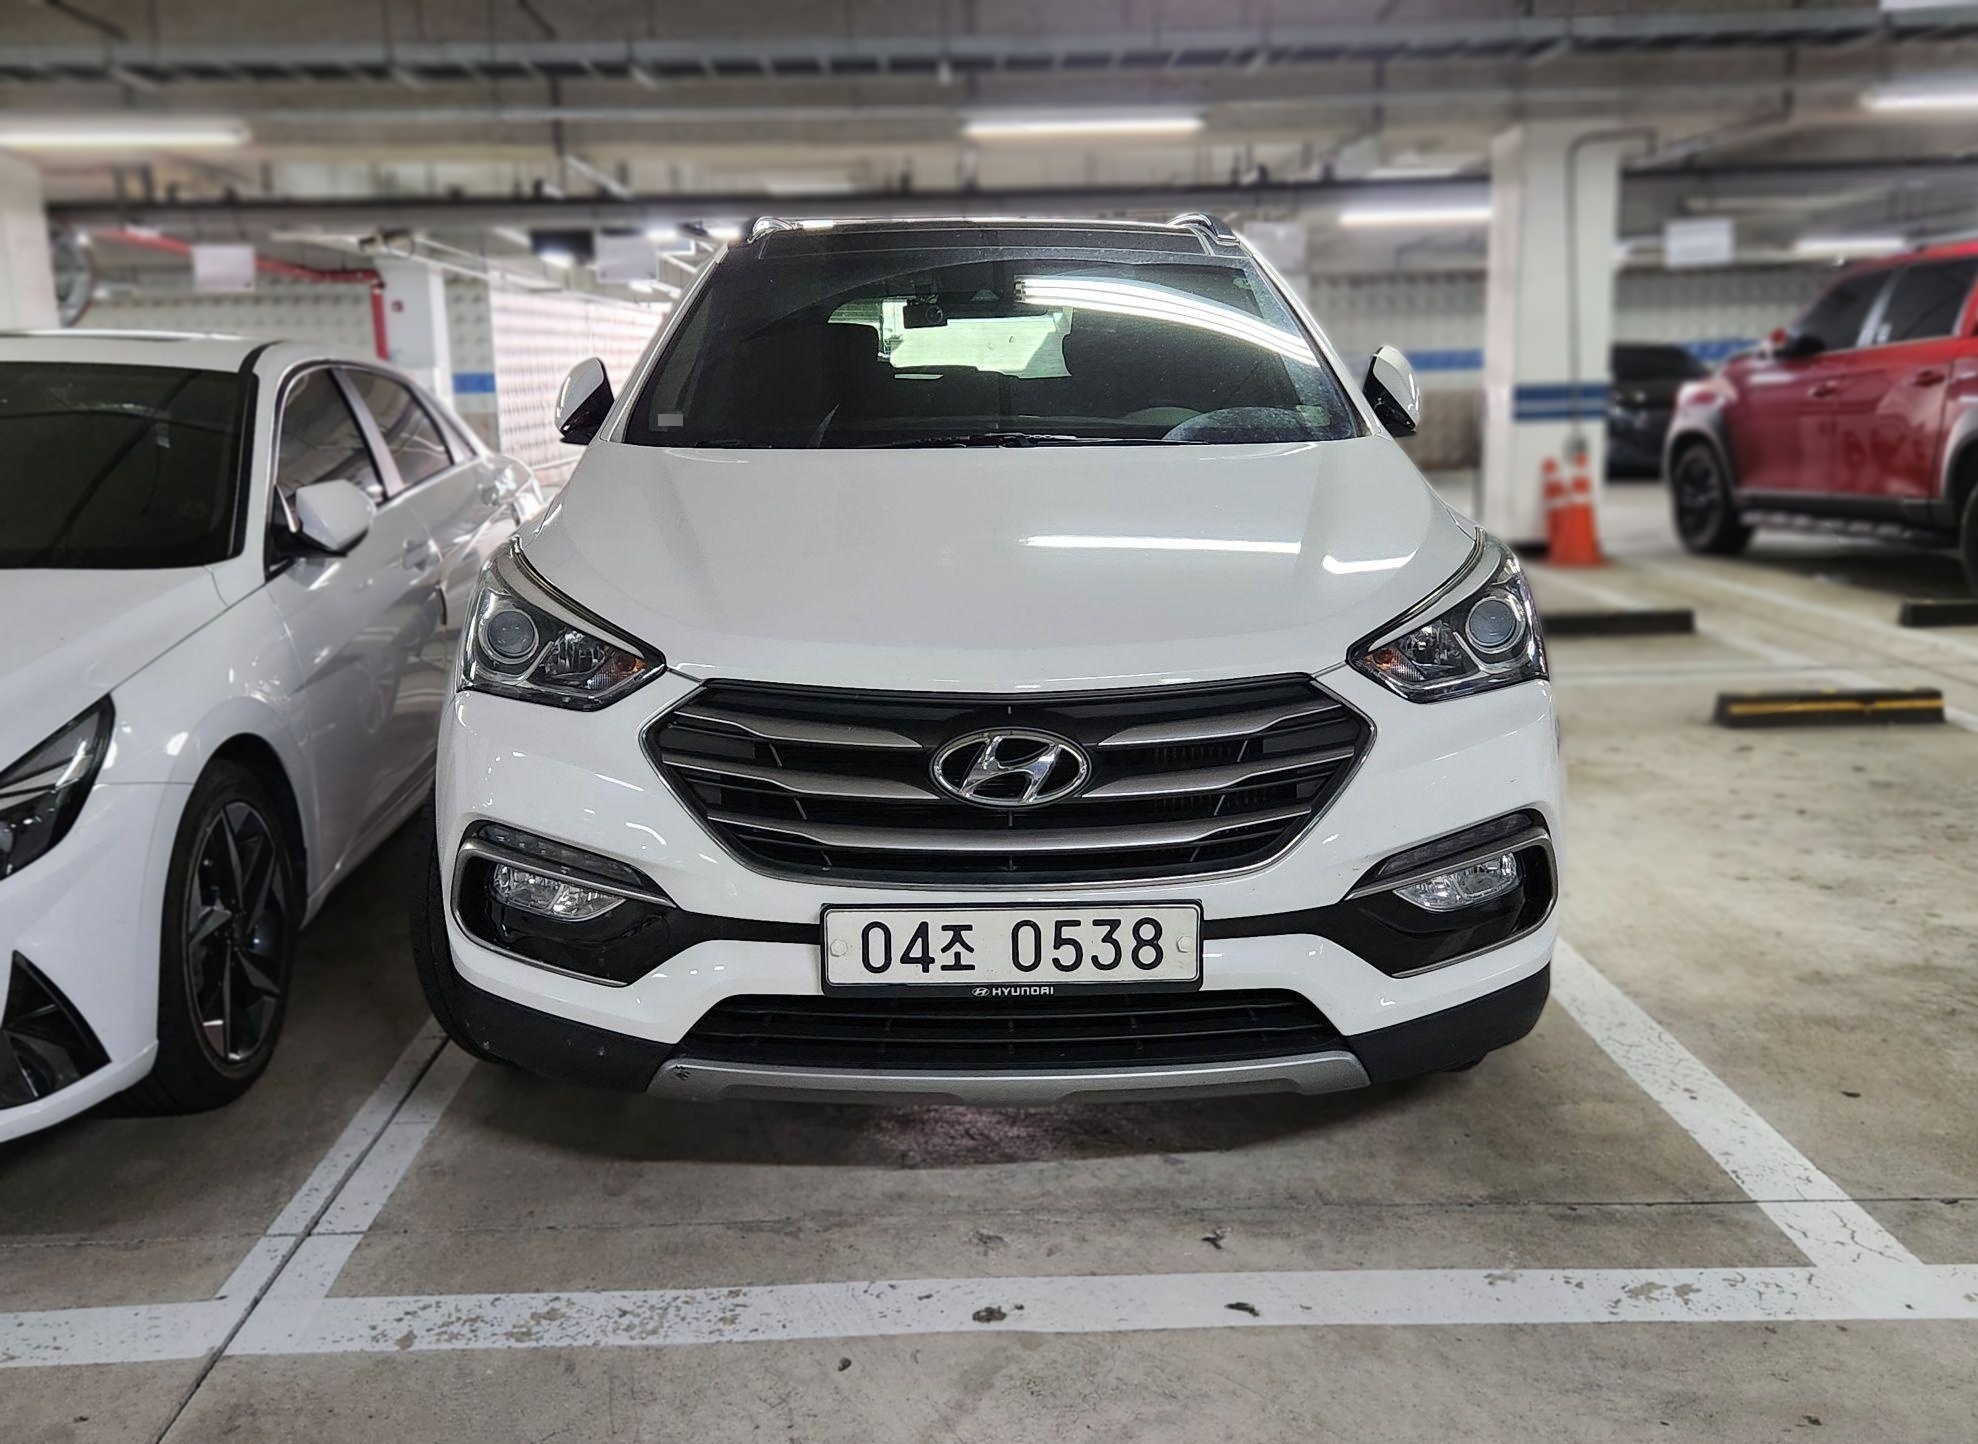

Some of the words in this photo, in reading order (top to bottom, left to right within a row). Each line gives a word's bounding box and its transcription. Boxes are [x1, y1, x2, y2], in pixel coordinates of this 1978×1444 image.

[861, 921, 976, 973] 04조
[1011, 917, 1164, 972] 0538
[992, 986, 1055, 996] HYUNDAI
